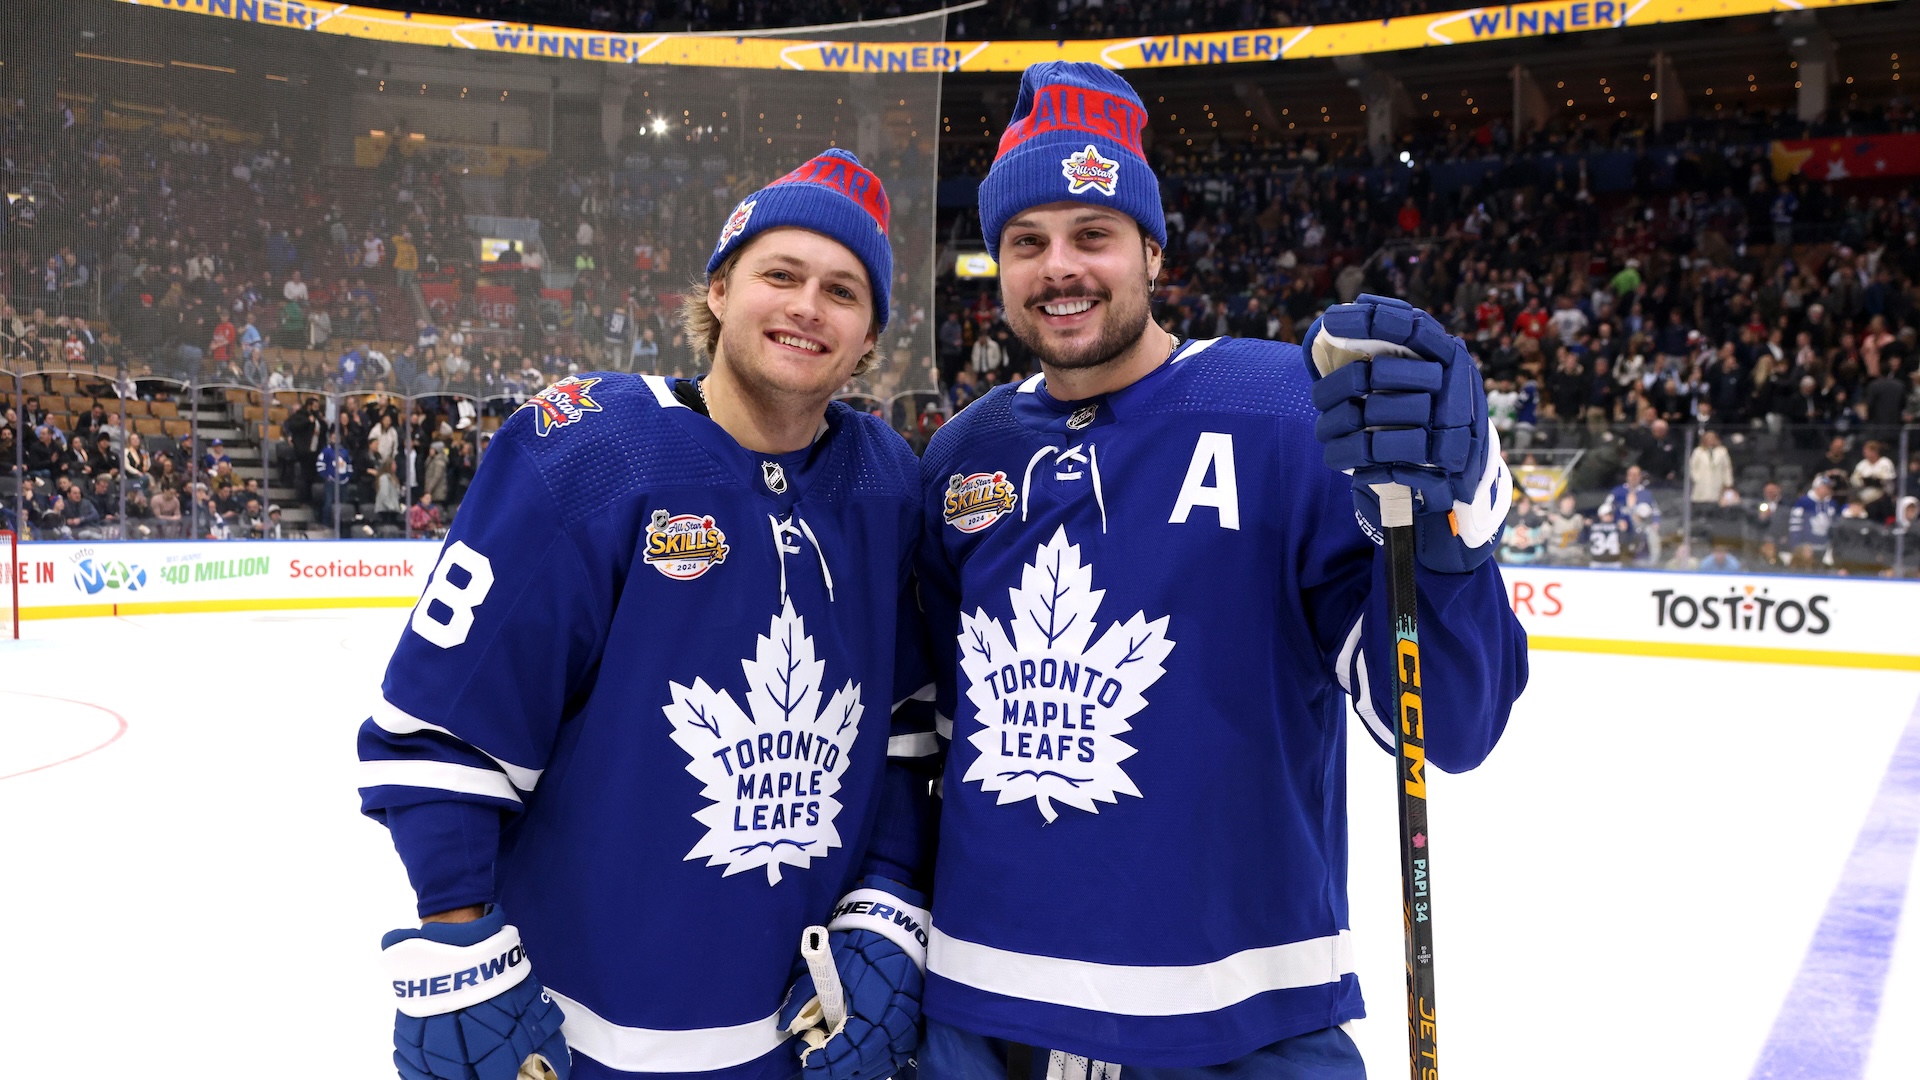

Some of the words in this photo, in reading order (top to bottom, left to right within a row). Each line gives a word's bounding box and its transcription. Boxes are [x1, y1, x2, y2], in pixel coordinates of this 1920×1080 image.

[1469, 2, 1627, 36] WINNER!
[494, 25, 638, 62] WINNER!
[820, 43, 960, 72] WINNER!
[1140, 35, 1283, 64] WINNER!
[1168, 431, 1240, 531] A
[946, 482, 1007, 514] SKILLS
[649, 530, 718, 555] SKILLS
[1589, 531, 1620, 556] 34
[36, 561, 54, 583] IN
[160, 564, 190, 585] $40
[195, 556, 270, 582] MILLION
[289, 559, 414, 578] Scotiabank
[676, 563, 697, 571] 2024
[411, 540, 495, 650] 8
[983, 658, 1122, 709] TORONTO
[1002, 698, 1096, 730] MAPLE
[1397, 638, 1427, 800] CCM
[712, 730, 840, 776] TORONTO
[1001, 731, 1095, 763] LEAFS
[736, 770, 823, 800] MAPLE
[733, 801, 820, 832] LEAFS
[1414, 859, 1427, 897] PAPI
[1415, 902, 1429, 923] 34
